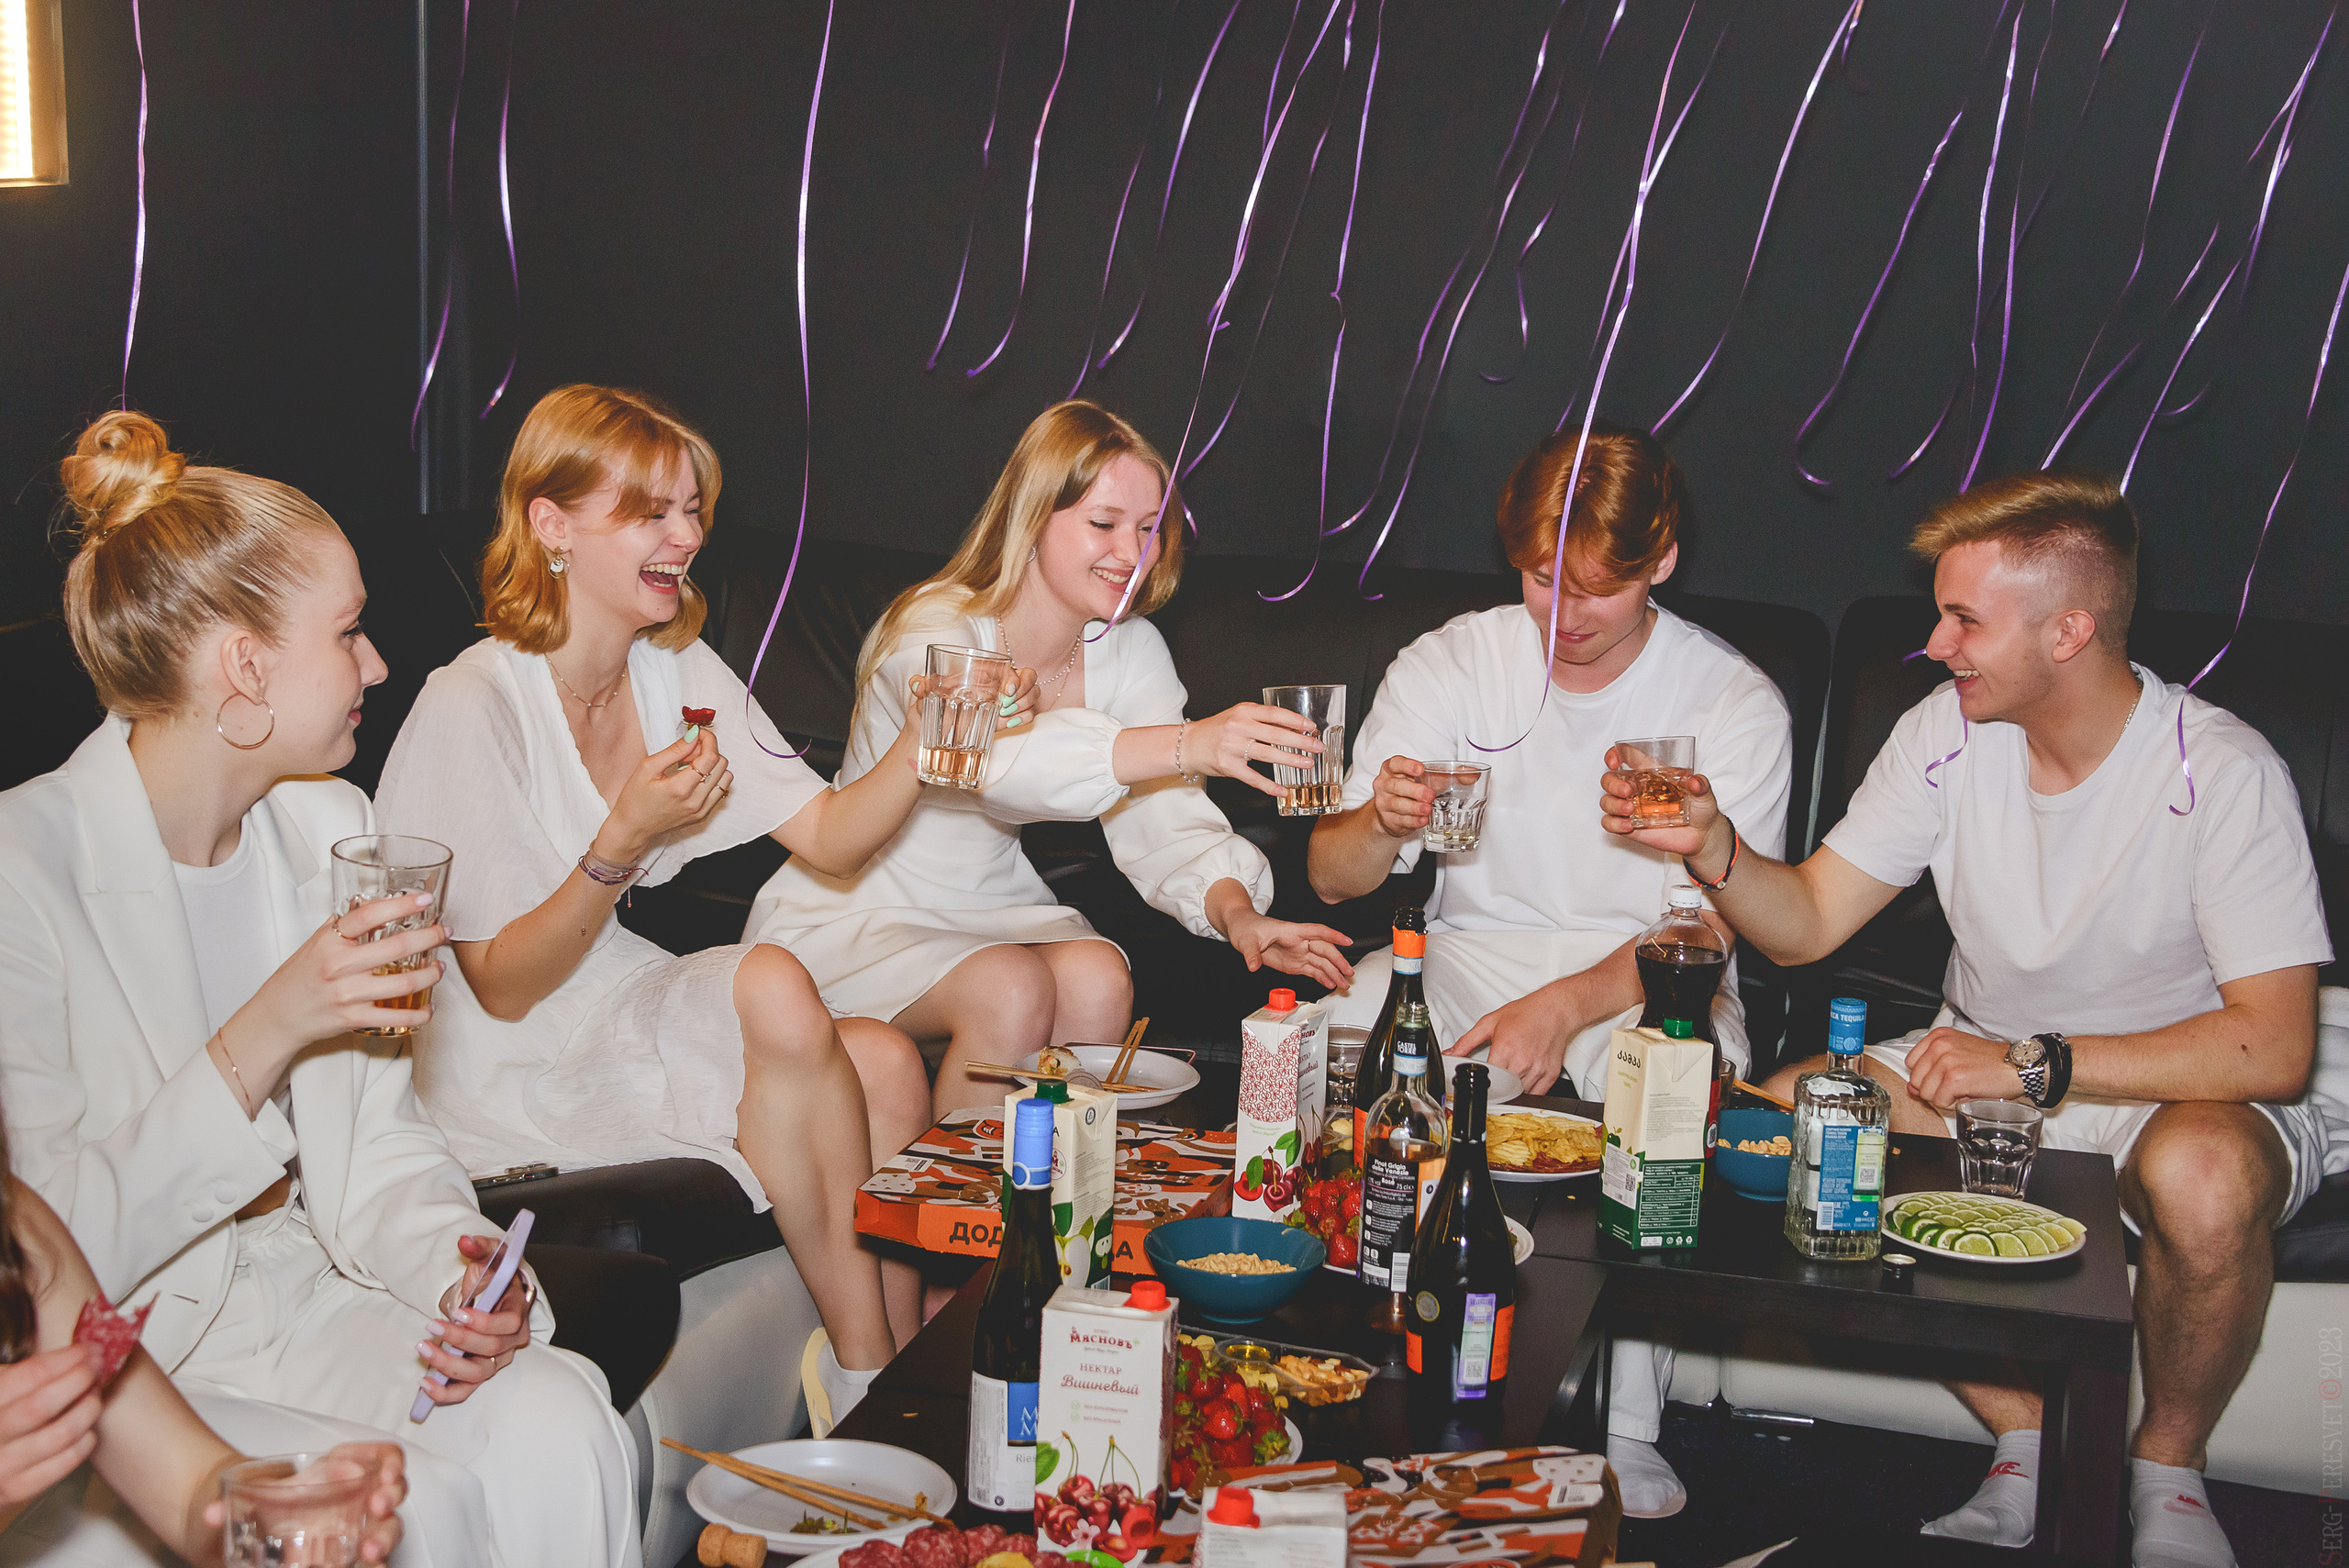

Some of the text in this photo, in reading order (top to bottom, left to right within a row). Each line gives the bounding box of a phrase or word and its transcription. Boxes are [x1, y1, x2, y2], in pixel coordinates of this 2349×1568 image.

[949, 1221, 1003, 1249] ДОД
[1079, 1362, 1122, 1375] НЕКТАР
[1061, 1374, 1139, 1396] Вишневый
[1016, 1452, 1037, 1463] Ries
